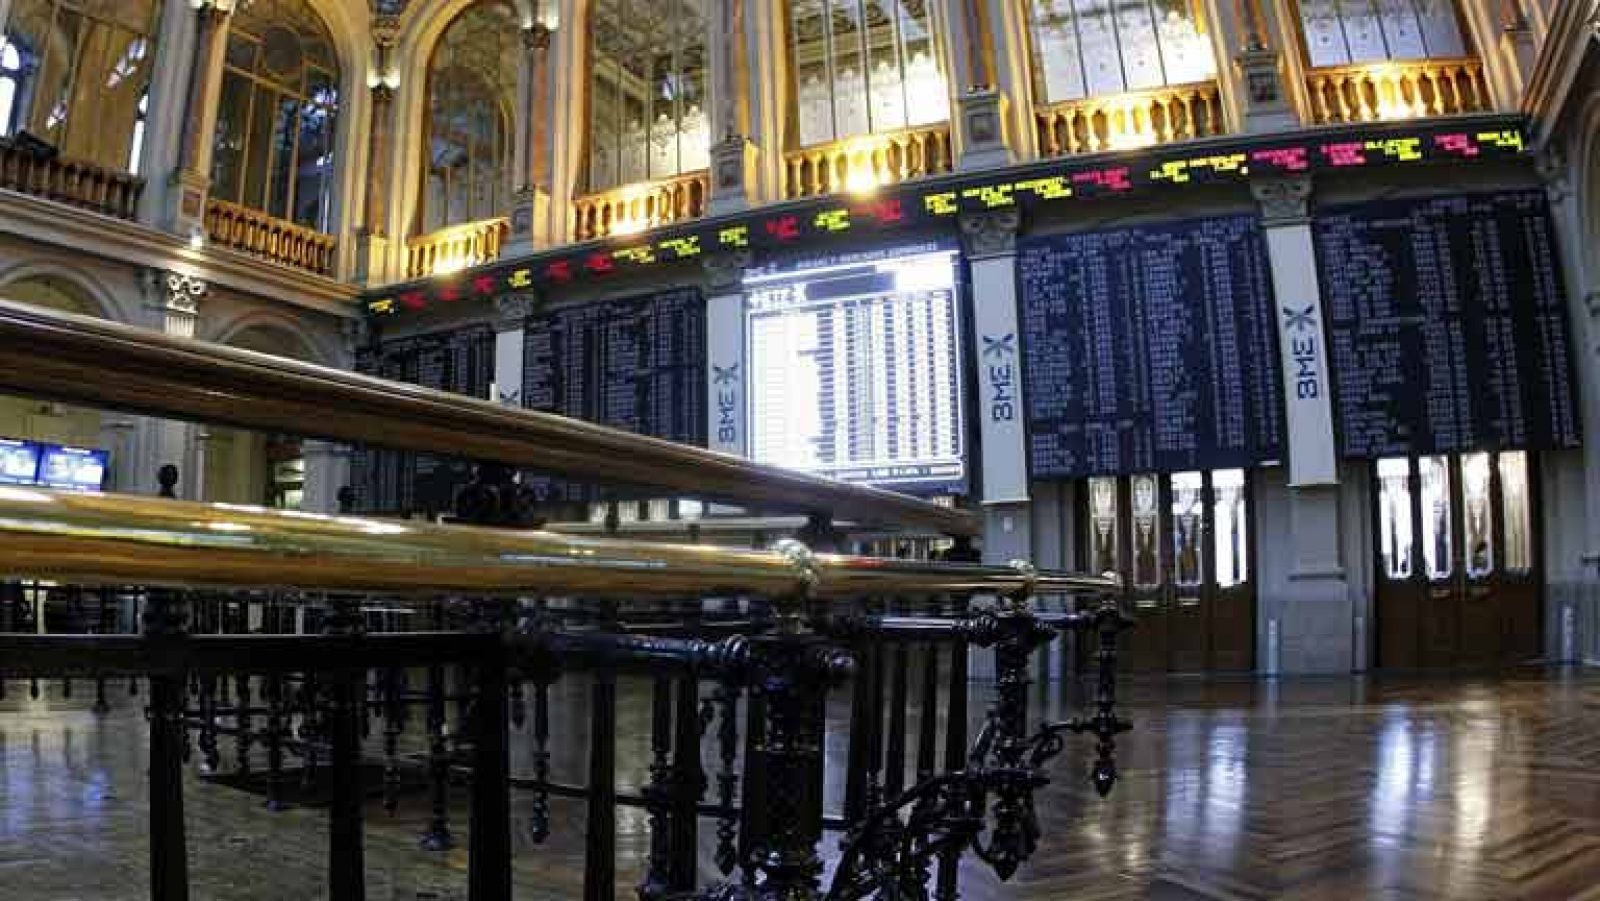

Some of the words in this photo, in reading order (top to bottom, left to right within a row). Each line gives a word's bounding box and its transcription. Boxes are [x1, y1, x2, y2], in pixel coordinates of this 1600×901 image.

[990, 364, 1013, 421] BME
[1292, 337, 1317, 400] BME
[719, 389, 735, 442] BME
